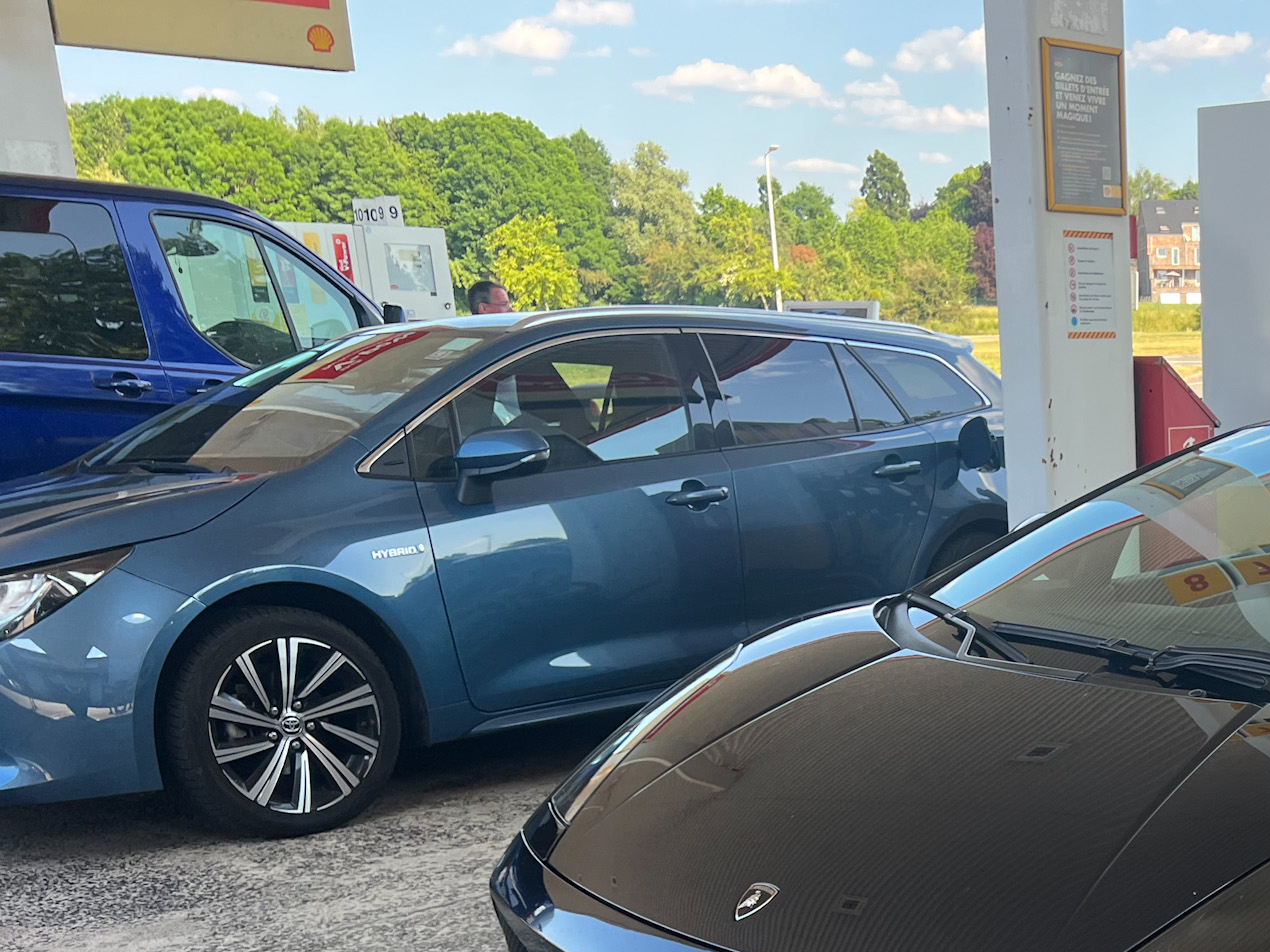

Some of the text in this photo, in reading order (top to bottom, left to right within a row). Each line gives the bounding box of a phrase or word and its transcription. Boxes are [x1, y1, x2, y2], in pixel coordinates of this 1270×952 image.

[1054, 72, 1097, 85] GAGNEZ DES
[1055, 81, 1110, 97] BILLETS D'ENTRÉE
[1055, 91, 1107, 106] ET VENEZ VIVRE
[1055, 101, 1099, 114] UN MOMENT
[354, 208, 363, 222] 10
[363, 208, 378, 221] 10
[378, 206, 384, 220] 9
[389, 206, 398, 219] 9
[371, 545, 419, 560] HYBRID
